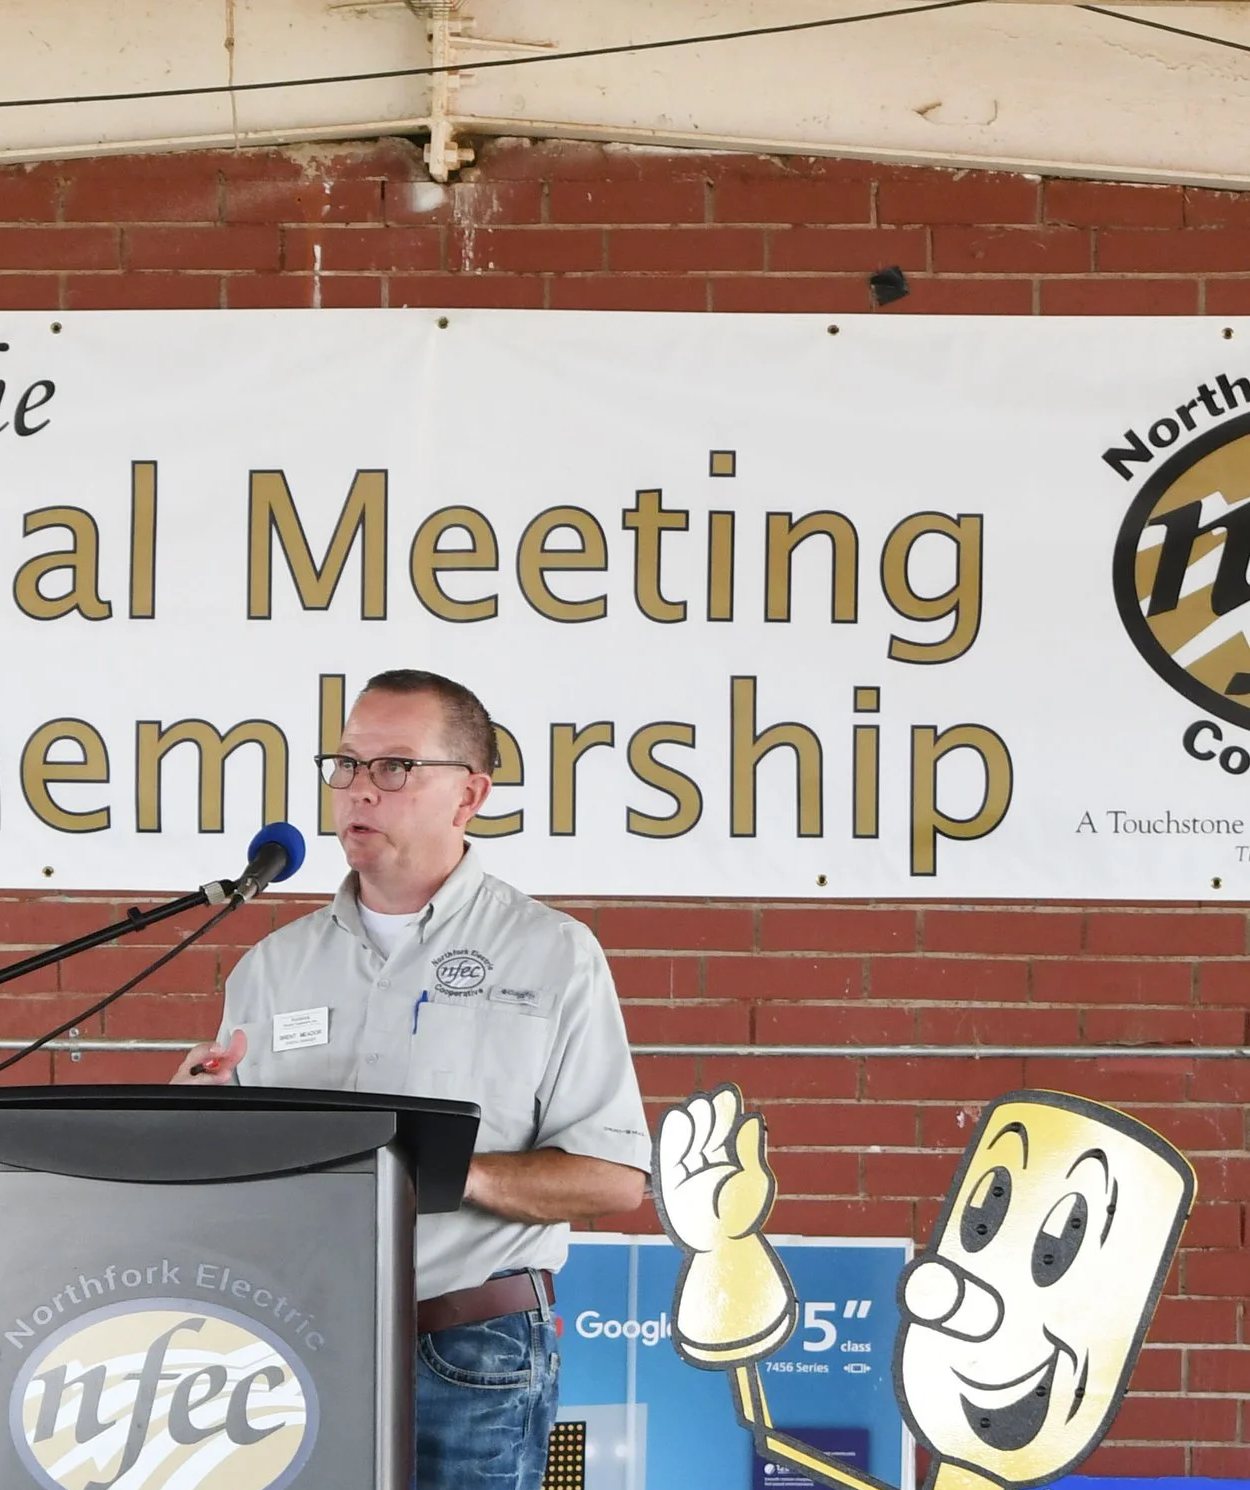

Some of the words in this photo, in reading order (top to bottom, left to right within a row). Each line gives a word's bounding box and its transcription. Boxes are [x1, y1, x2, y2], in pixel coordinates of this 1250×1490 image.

[244, 450, 986, 666] Meeting
[1076, 811, 1097, 834] A
[1106, 810, 1244, 836] Touchstone
[434, 983, 484, 997] Cooperative
[4, 1258, 180, 1350] Northfork
[196, 1263, 327, 1353] Electric
[575, 1310, 673, 1346] Googl
[840, 1339, 873, 1353] class
[765, 1361, 794, 1374] 7456
[795, 1361, 829, 1374] Series
